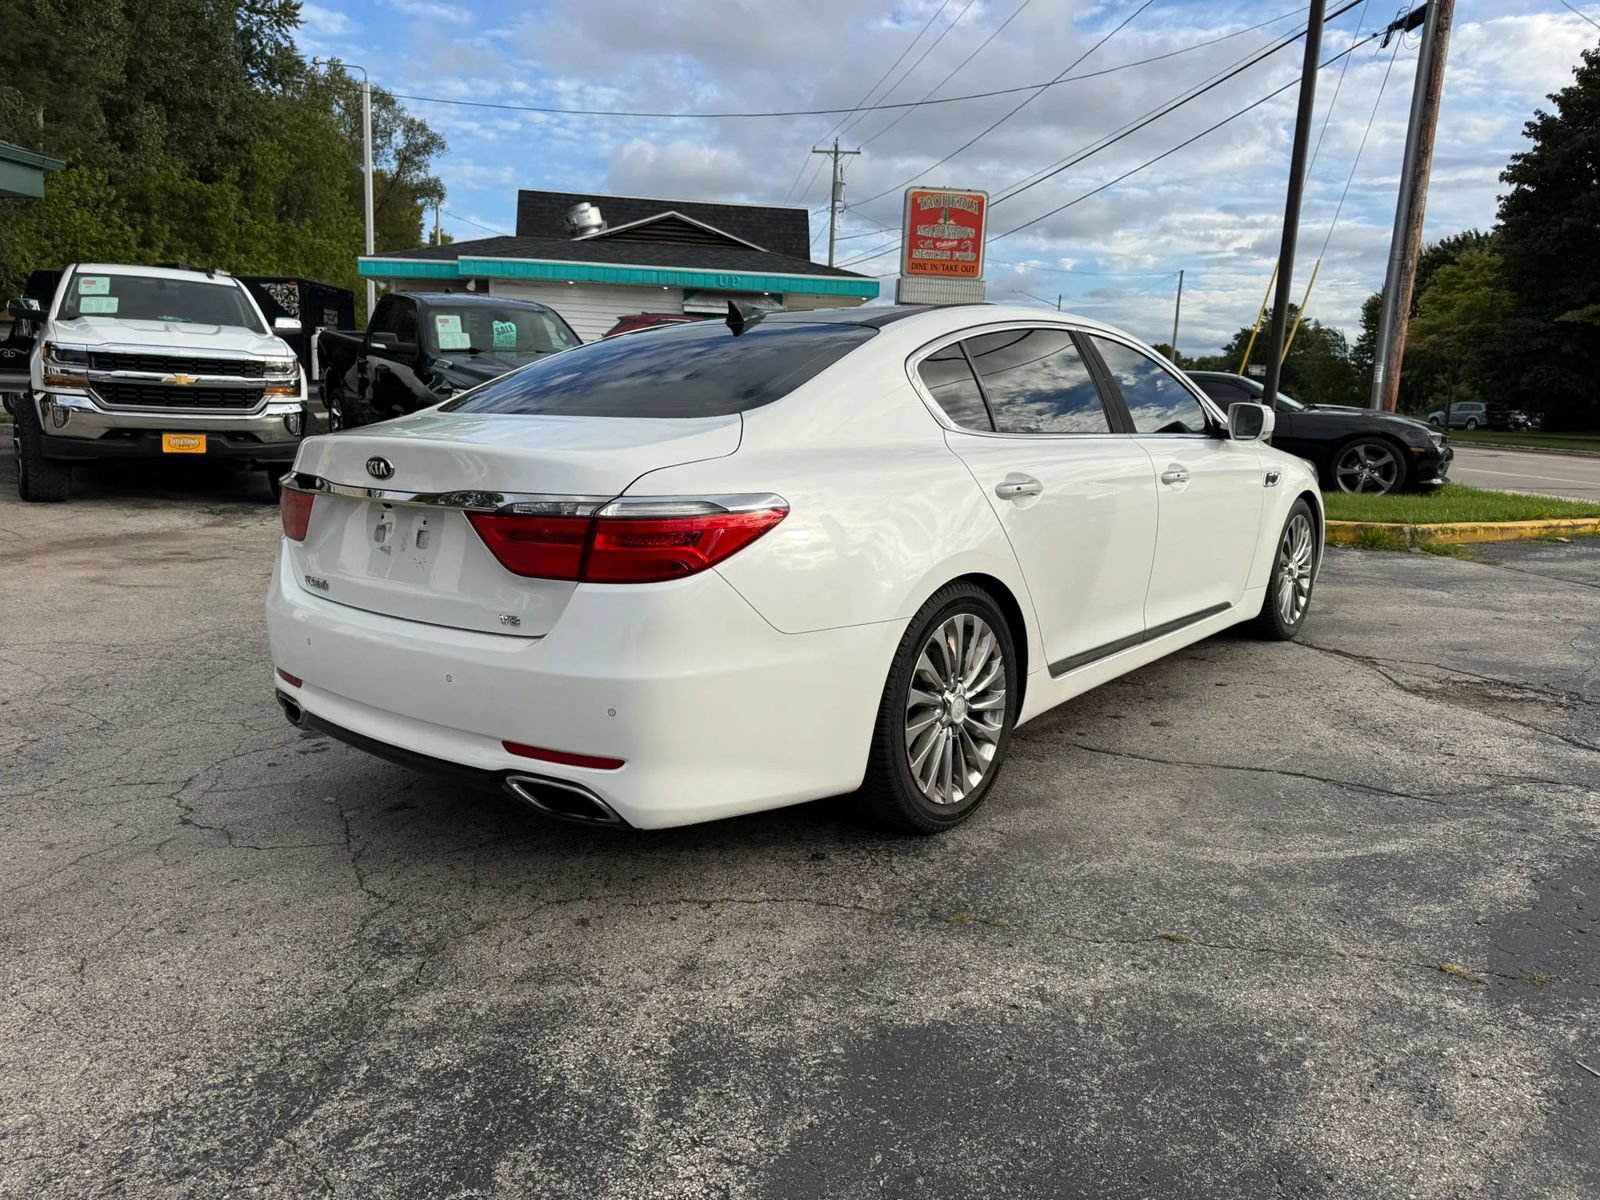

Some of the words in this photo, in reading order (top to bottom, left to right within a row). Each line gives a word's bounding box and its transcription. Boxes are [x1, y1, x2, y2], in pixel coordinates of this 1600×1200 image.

[917, 194, 979, 215] TAQUERIA
[912, 249, 951, 259] MEXICAN
[952, 251, 977, 261] FOOD
[911, 263, 928, 271] DINE
[961, 265, 976, 273] OUT
[719, 275, 740, 288] UP
[495, 324, 515, 336] SALE
[367, 460, 388, 476] KIA
